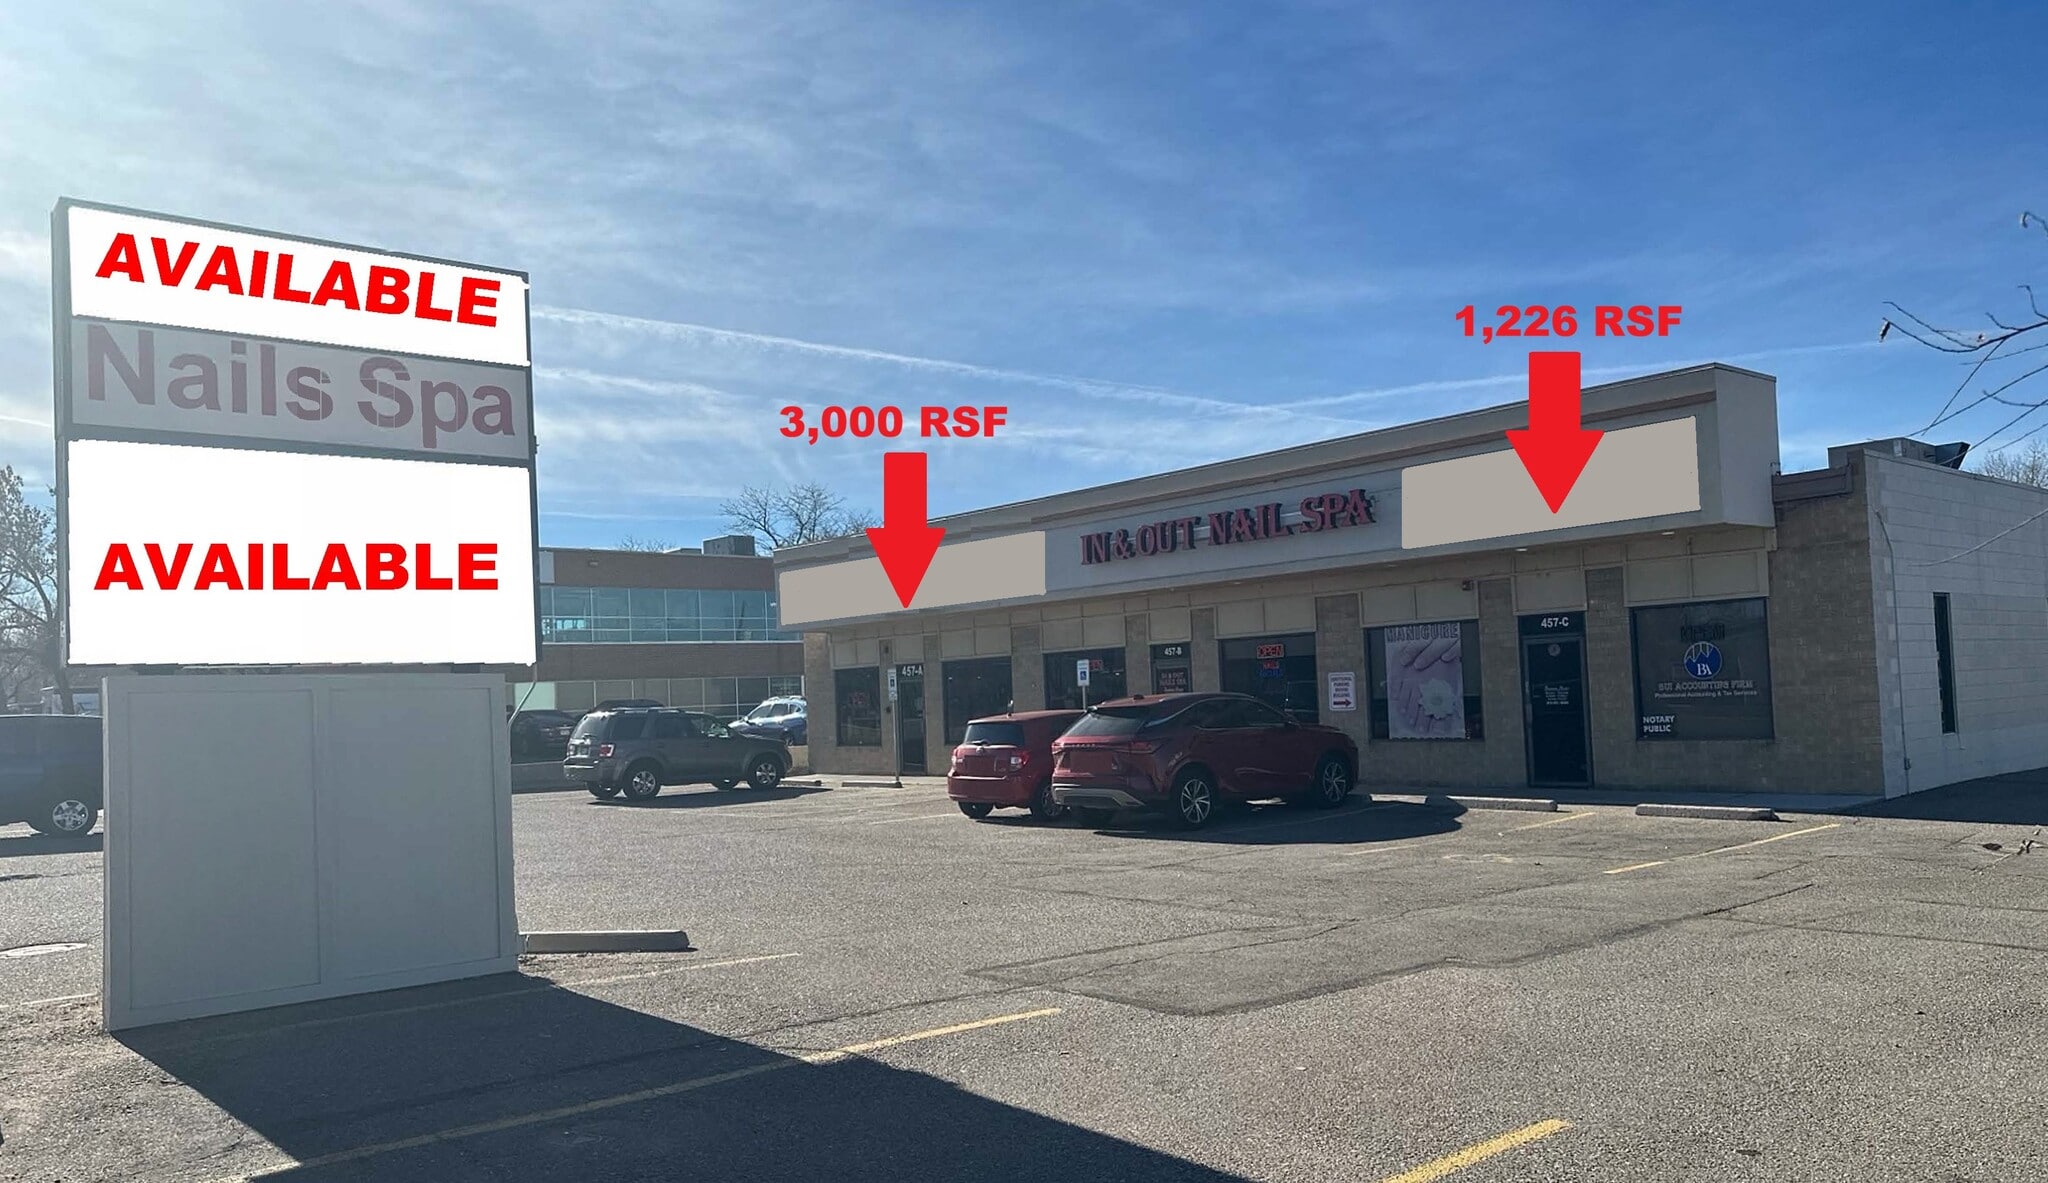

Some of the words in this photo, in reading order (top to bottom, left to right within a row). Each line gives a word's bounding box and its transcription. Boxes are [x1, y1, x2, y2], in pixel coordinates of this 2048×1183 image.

[88, 324, 334, 421] Nails
[358, 357, 516, 448] Spa
[1207, 502, 1294, 547] NAIL
[1300, 488, 1377, 534] SPA
[1541, 617, 1569, 628] 457-C
[1386, 623, 1459, 643] MANICURE
[1259, 645, 1283, 656] OPEN
[901, 665, 924, 676] 457-A
[1643, 715, 1675, 724] NOTARY
[1643, 724, 1671, 733] PUBLIC
